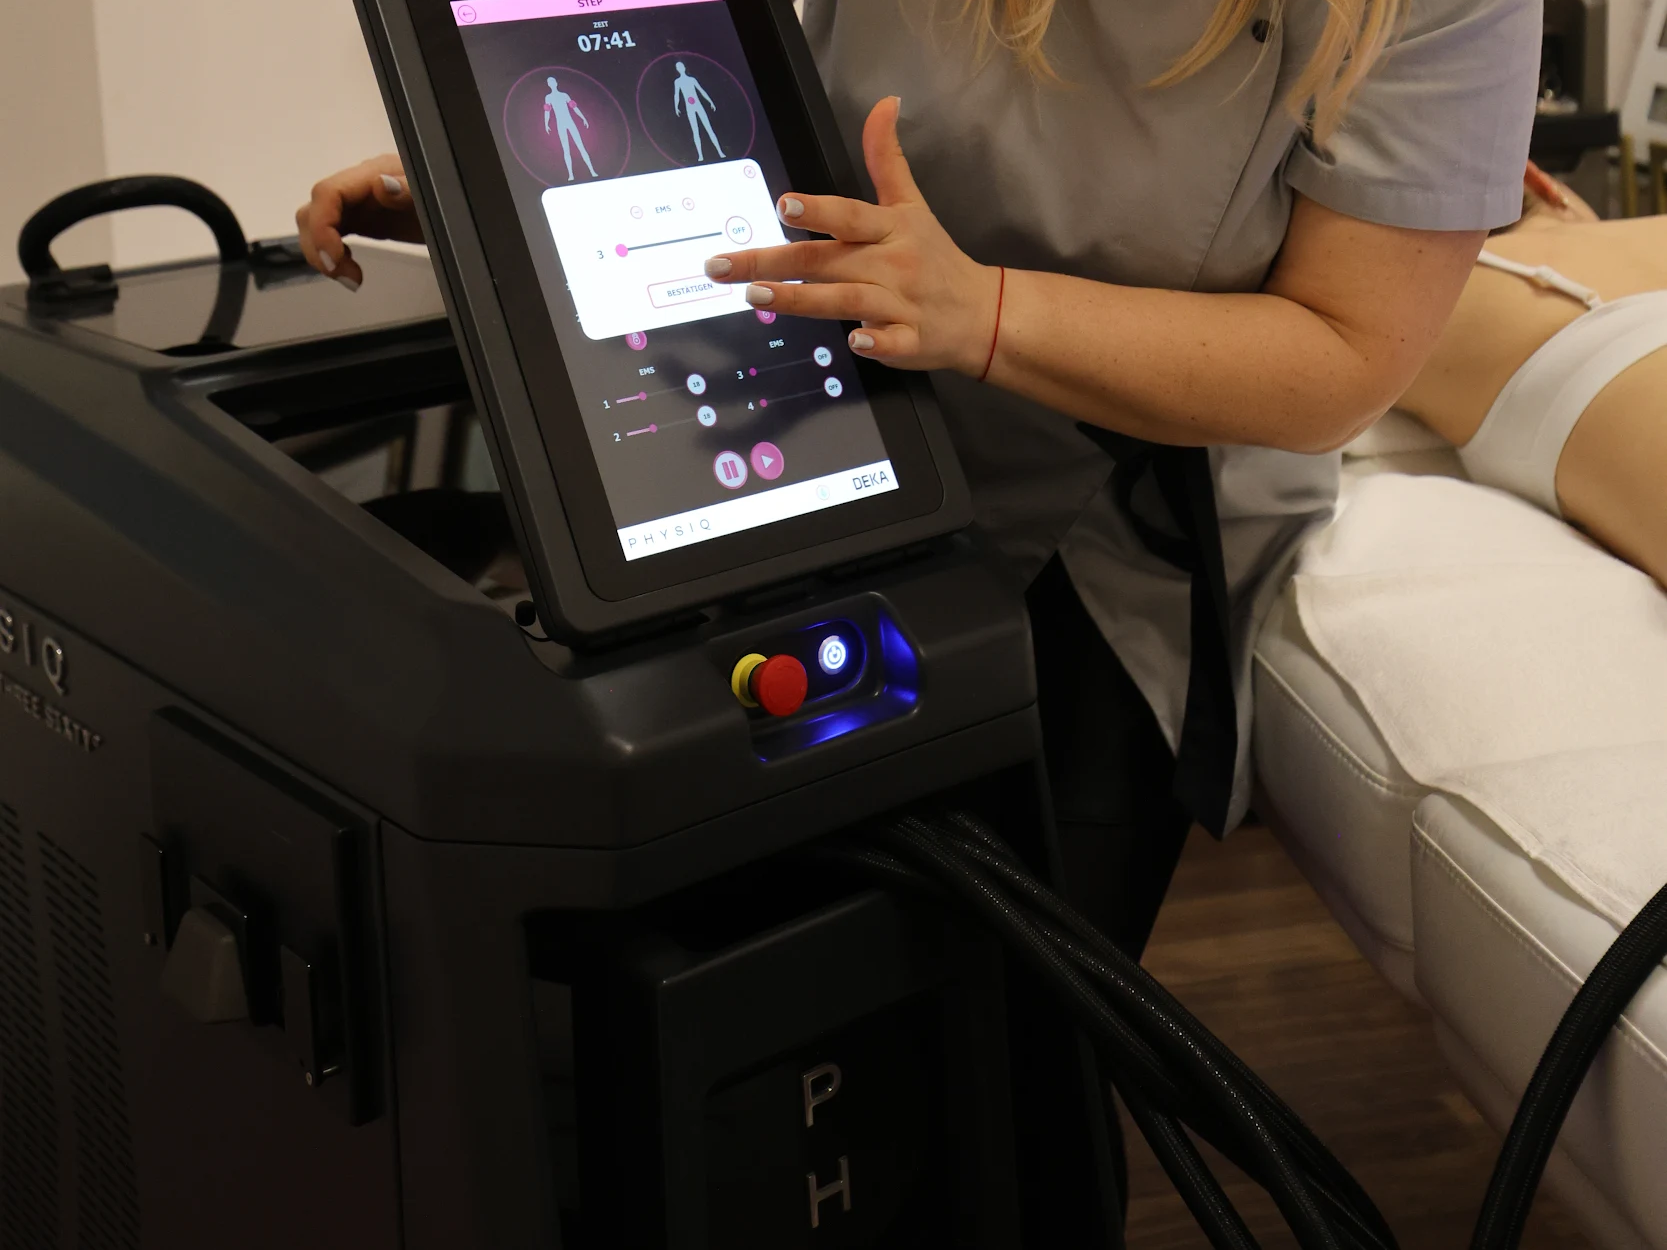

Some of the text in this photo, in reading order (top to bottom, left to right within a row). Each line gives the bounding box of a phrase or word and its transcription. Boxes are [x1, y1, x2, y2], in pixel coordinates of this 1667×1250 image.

[592, 20, 609, 29] ZEIT
[577, 30, 637, 52] 07:41
[654, 204, 672, 214] EMS
[596, 226, 746, 260] 3 OFF
[768, 339, 785, 349] EMS
[638, 366, 656, 376] EMS
[736, 353, 828, 380] 3 OFF
[602, 399, 611, 410] 1
[747, 383, 839, 411] 4 OFF
[613, 432, 622, 442] 2
[852, 470, 890, 492] DEKA
[627, 518, 712, 549] PHYSIQ
